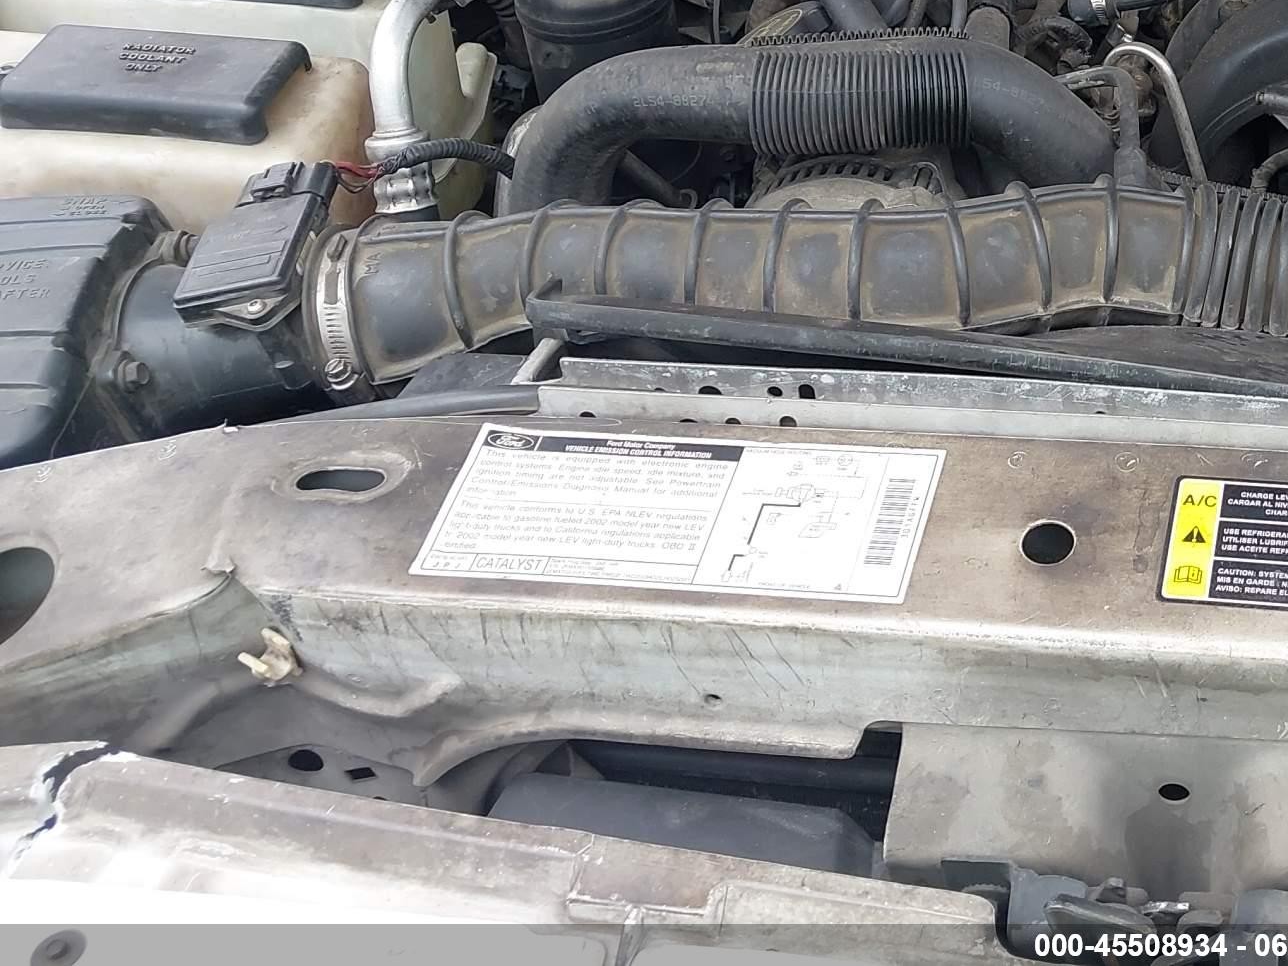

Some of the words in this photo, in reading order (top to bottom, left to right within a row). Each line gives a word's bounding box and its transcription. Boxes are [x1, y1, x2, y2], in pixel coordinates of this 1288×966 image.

[123, 43, 196, 55] RADIATOR
[119, 52, 187, 64] COOLANT
[607, 440, 623, 448] Ford
[624, 441, 643, 449] Motor
[644, 442, 676, 451] Company
[565, 445, 593, 453] VEHICLE
[594, 446, 629, 455] EMISSION
[630, 448, 662, 457] CONTROL
[663, 450, 712, 459] INFORMATION
[1183, 494, 1217, 507] A/C
[1240, 491, 1273, 499] CHARGE
[1227, 498, 1261, 506] CARGAR
[1223, 527, 1239, 535] USE
[1222, 535, 1257, 544] UTILISER
[1221, 542, 1237, 551] USE
[1238, 544, 1267, 553] ACEITE
[476, 556, 543, 572] CATALYST
[1217, 567, 1256, 577] CAUTION:
[1216, 575, 1231, 584] MIS
[1232, 576, 1244, 585] EN
[1245, 577, 1275, 587] GARDE
[1215, 584, 1242, 593] AVISO:
[1244, 586, 1277, 596] REPARE
[1279, 589, 1288, 597] EL
